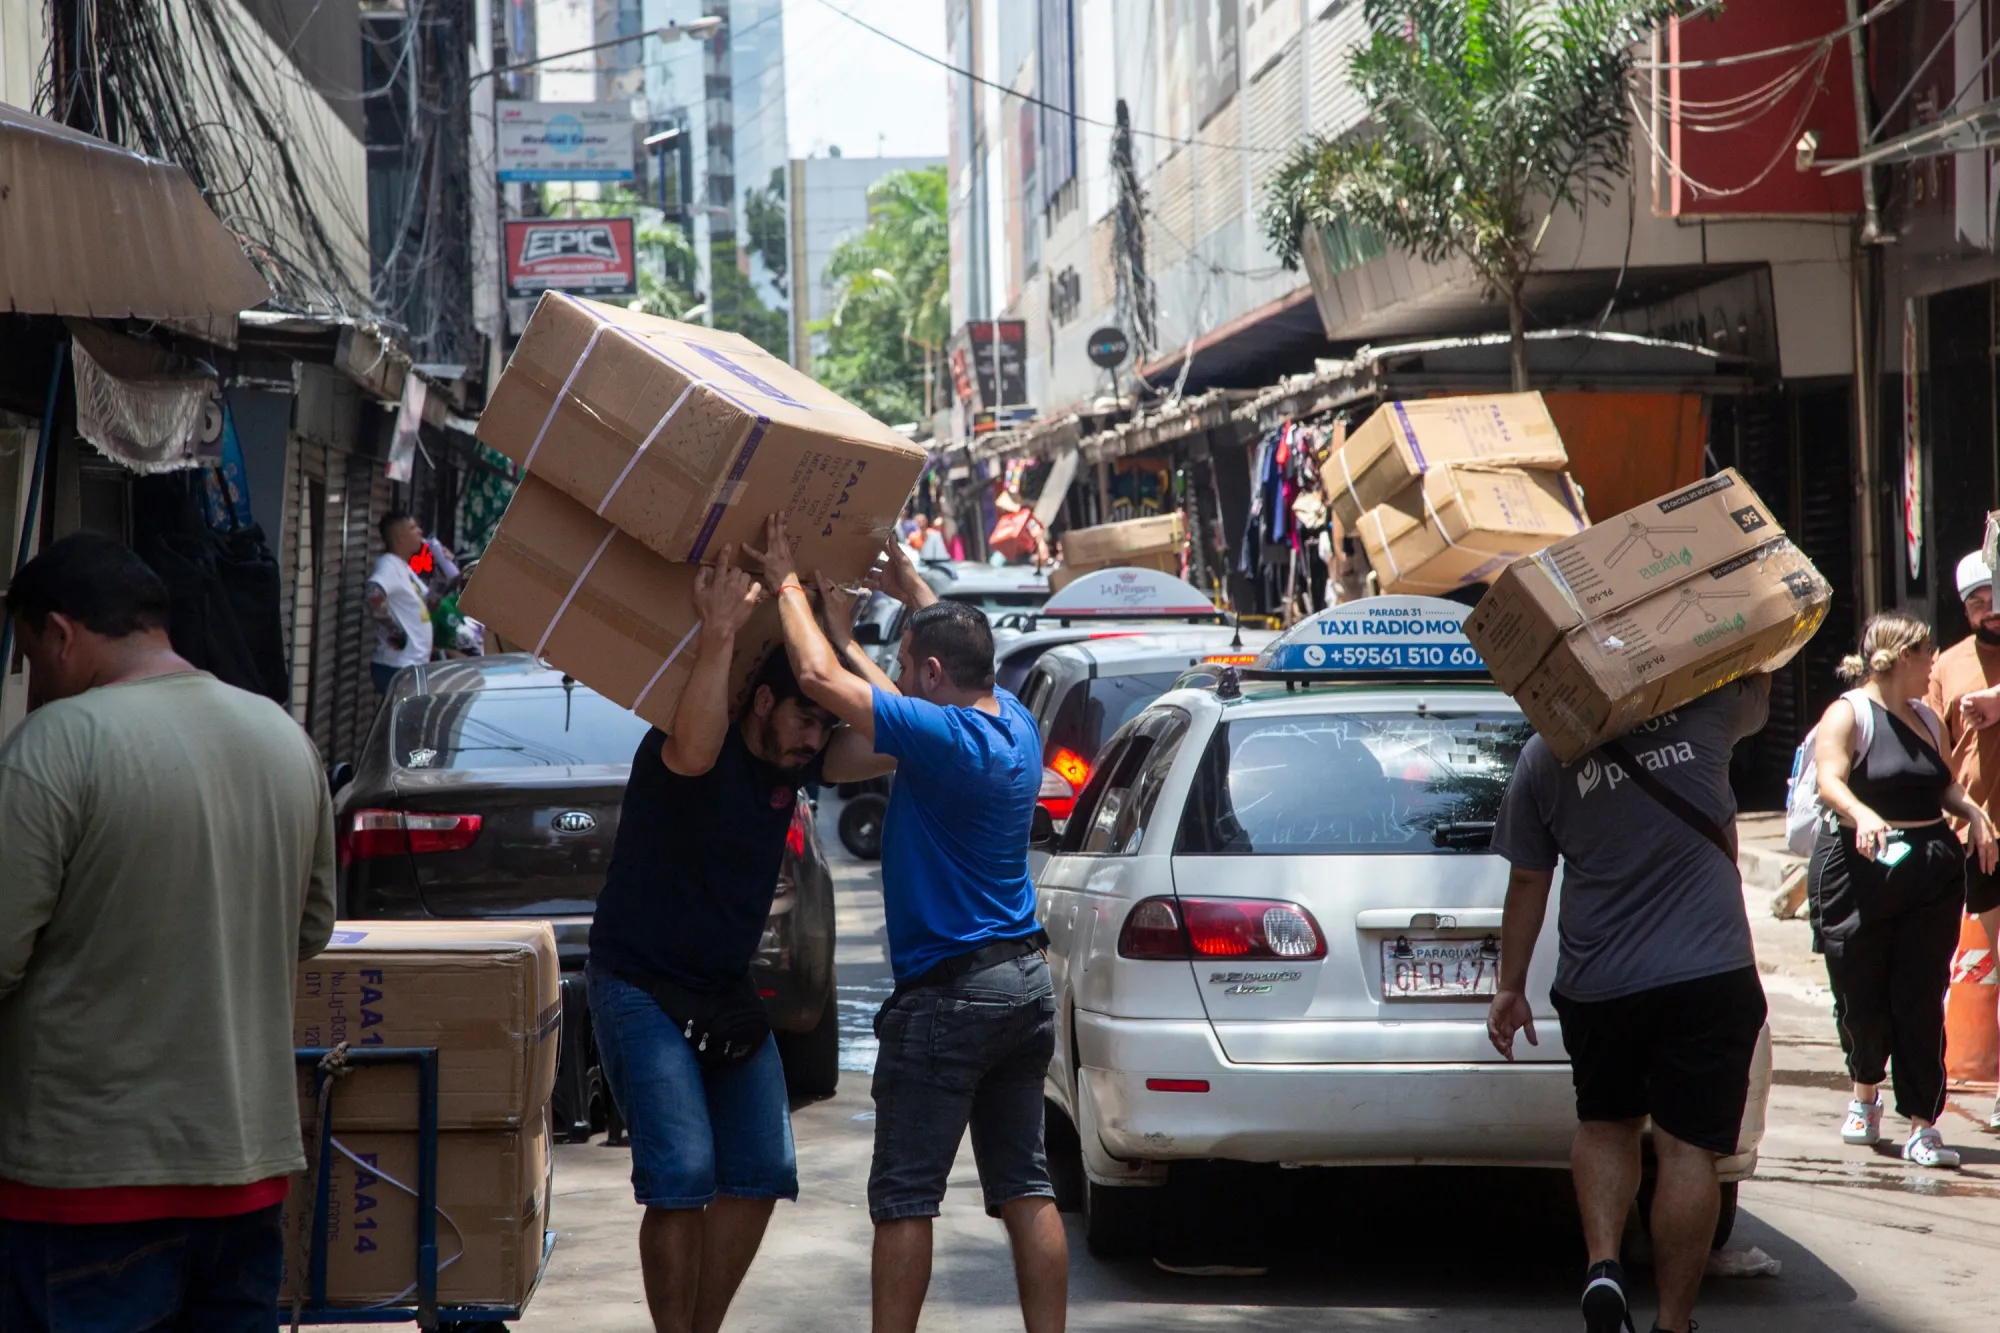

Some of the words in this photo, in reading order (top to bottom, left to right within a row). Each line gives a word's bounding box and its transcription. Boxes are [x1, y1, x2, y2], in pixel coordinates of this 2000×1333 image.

[527, 230, 612, 259] EPIC
[822, 460, 867, 537] FAA14
[1638, 552, 1680, 579] parana
[1369, 608, 1409, 617] PARADA
[1411, 608, 1421, 616] 31
[1318, 620, 1358, 635] TAXI
[1692, 616, 1734, 647] parana
[1331, 647, 1402, 665] +59561
[1408, 647, 1443, 665] 510
[1450, 647, 1484, 665] 60
[1636, 654, 1666, 674] PA-540
[1604, 740, 1696, 790] prana
[560, 816, 593, 830] KIA
[1416, 948, 1478, 959] PARAGUAY
[305, 971, 320, 998] QTY
[360, 969, 384, 1046] FAA1
[355, 1153, 378, 1254] FAA14
